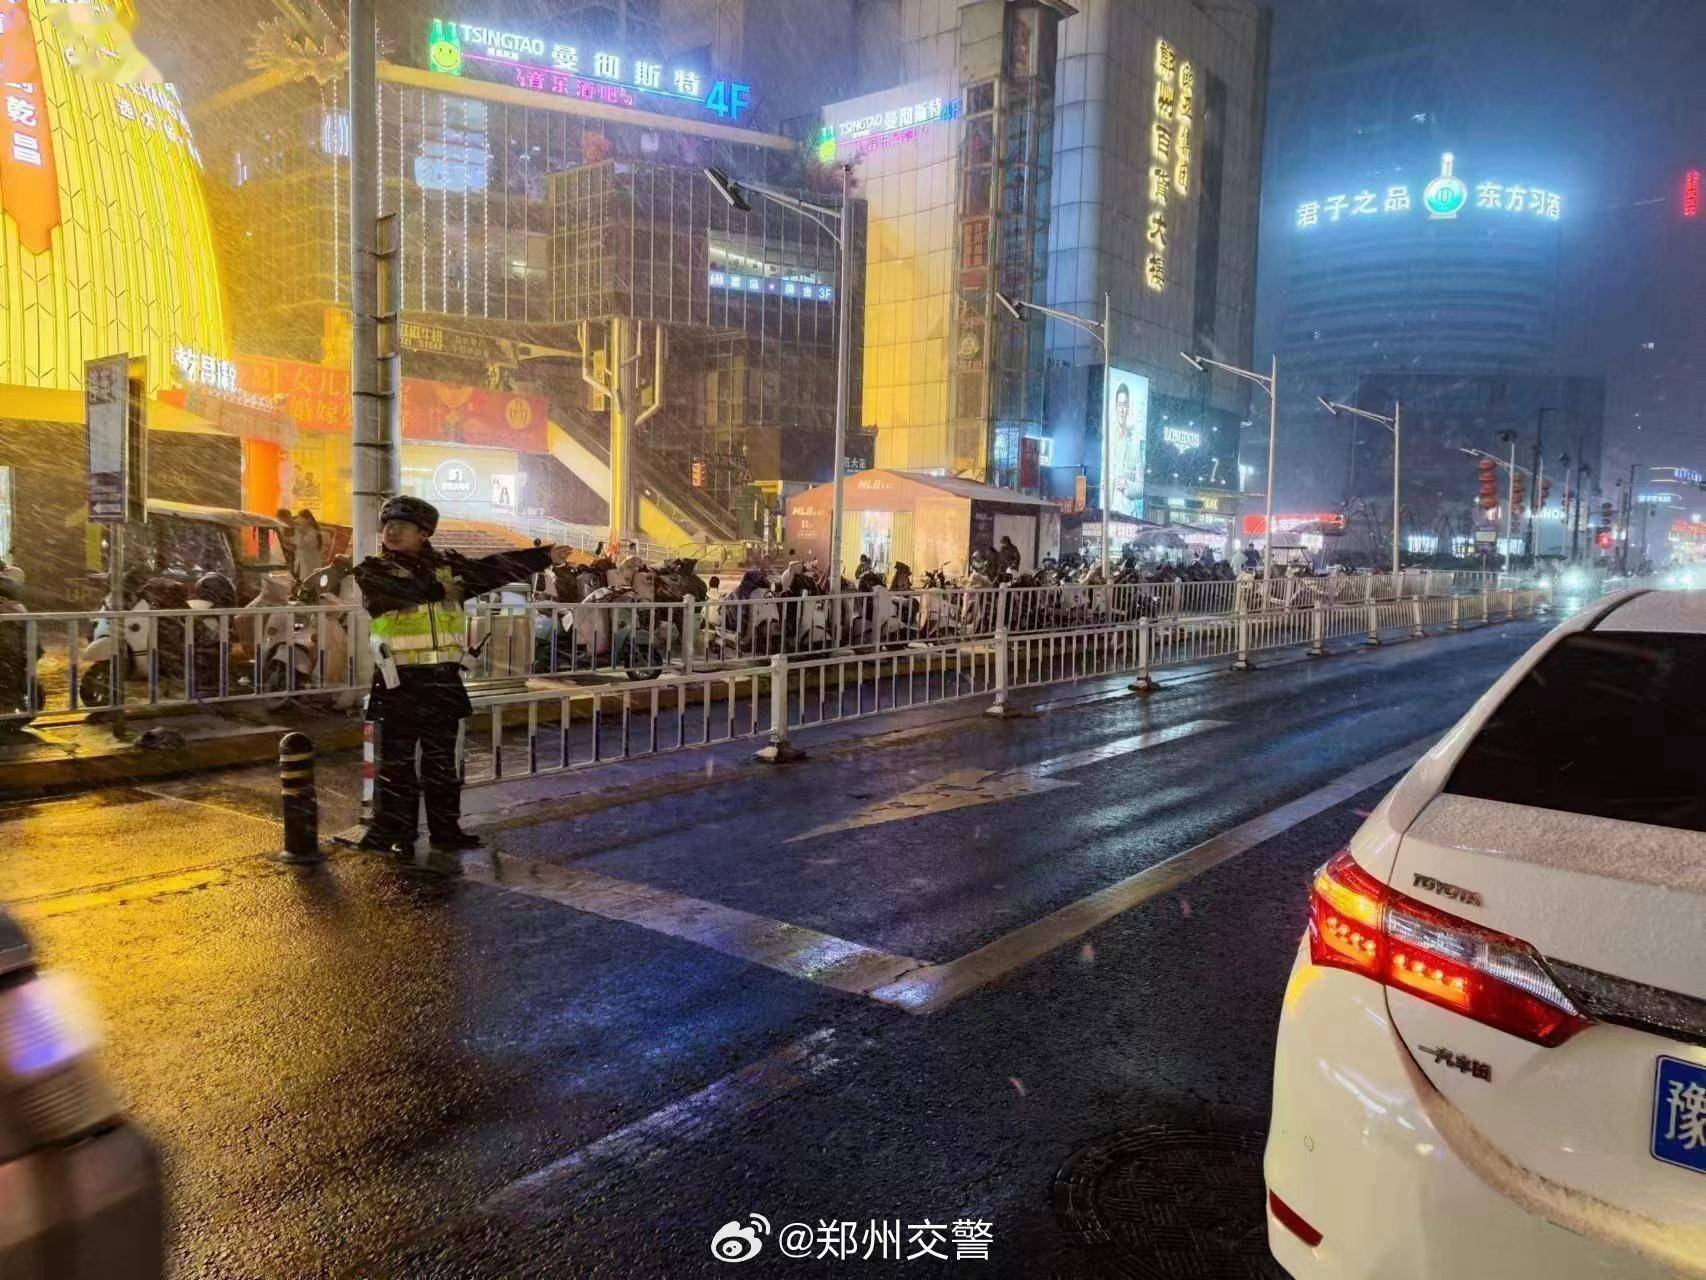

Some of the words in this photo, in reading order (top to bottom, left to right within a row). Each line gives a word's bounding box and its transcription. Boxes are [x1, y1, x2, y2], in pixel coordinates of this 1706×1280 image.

[460, 24, 544, 56] TSINGTAO
[551, 43, 700, 96] 曼彻斯特
[705, 80, 750, 120] 4F
[527, 70, 618, 103] 音乐酒吧
[1296, 185, 1410, 227] 君子之品
[1476, 181, 1561, 220] 东方习酒
[857, 479, 881, 489] MLB
[1412, 872, 1482, 907] TOYOTA
[1663, 1079, 1706, 1150] 豫
